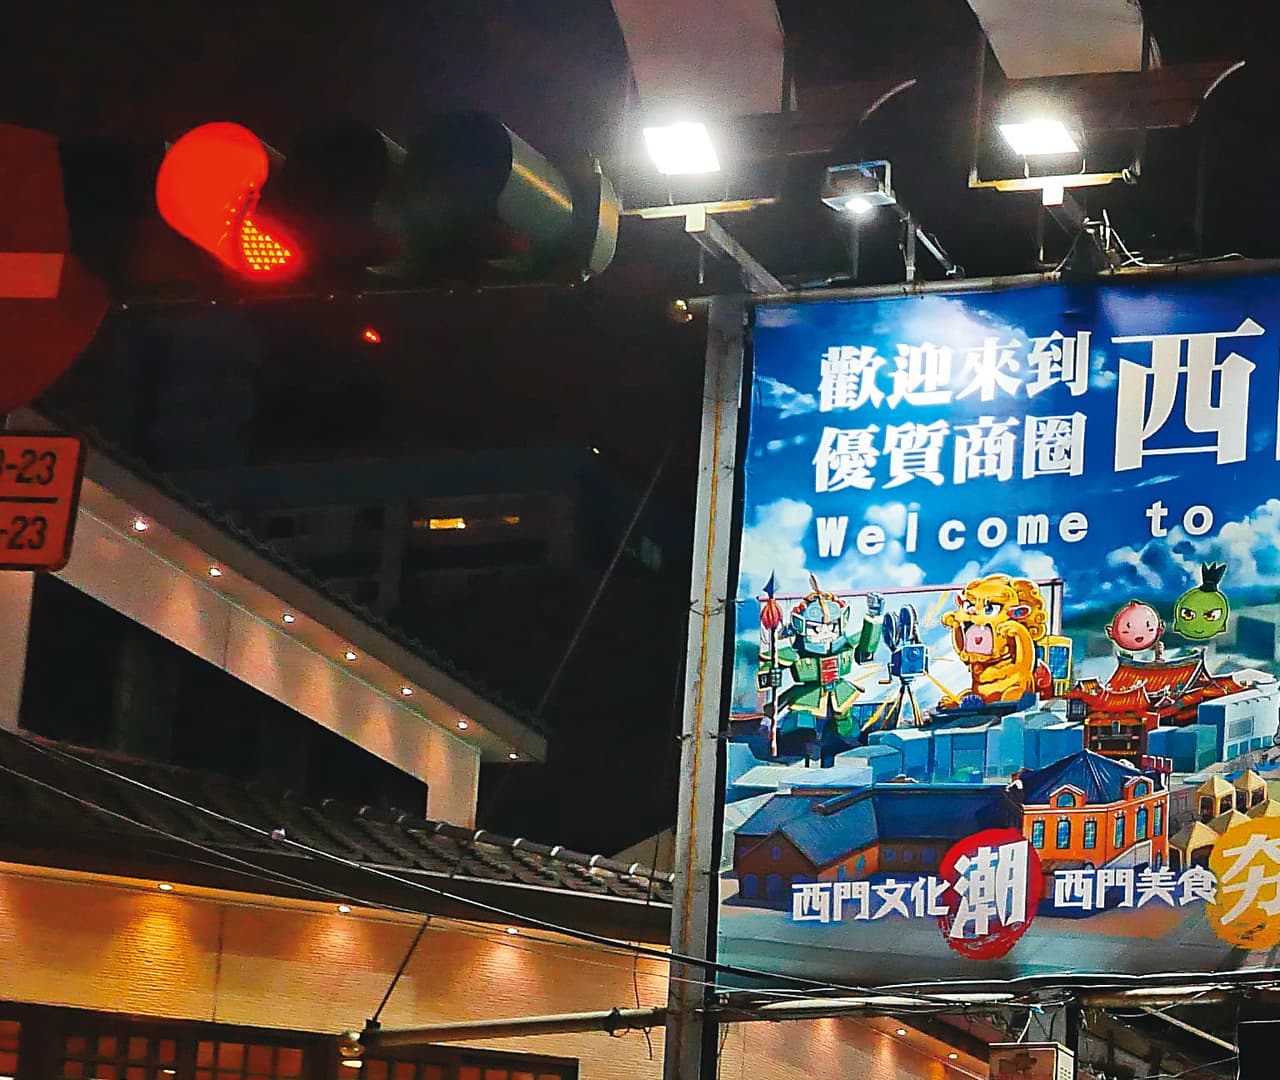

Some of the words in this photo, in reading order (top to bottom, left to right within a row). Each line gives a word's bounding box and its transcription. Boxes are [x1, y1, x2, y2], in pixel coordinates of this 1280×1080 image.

[818, 330, 1091, 412] 歡迎來到
[813, 411, 1088, 492] 優質商圈
[816, 509, 1089, 558] Welcome
[1149, 498, 1213, 536] to
[792, 838, 1028, 940] 西門文化潮
